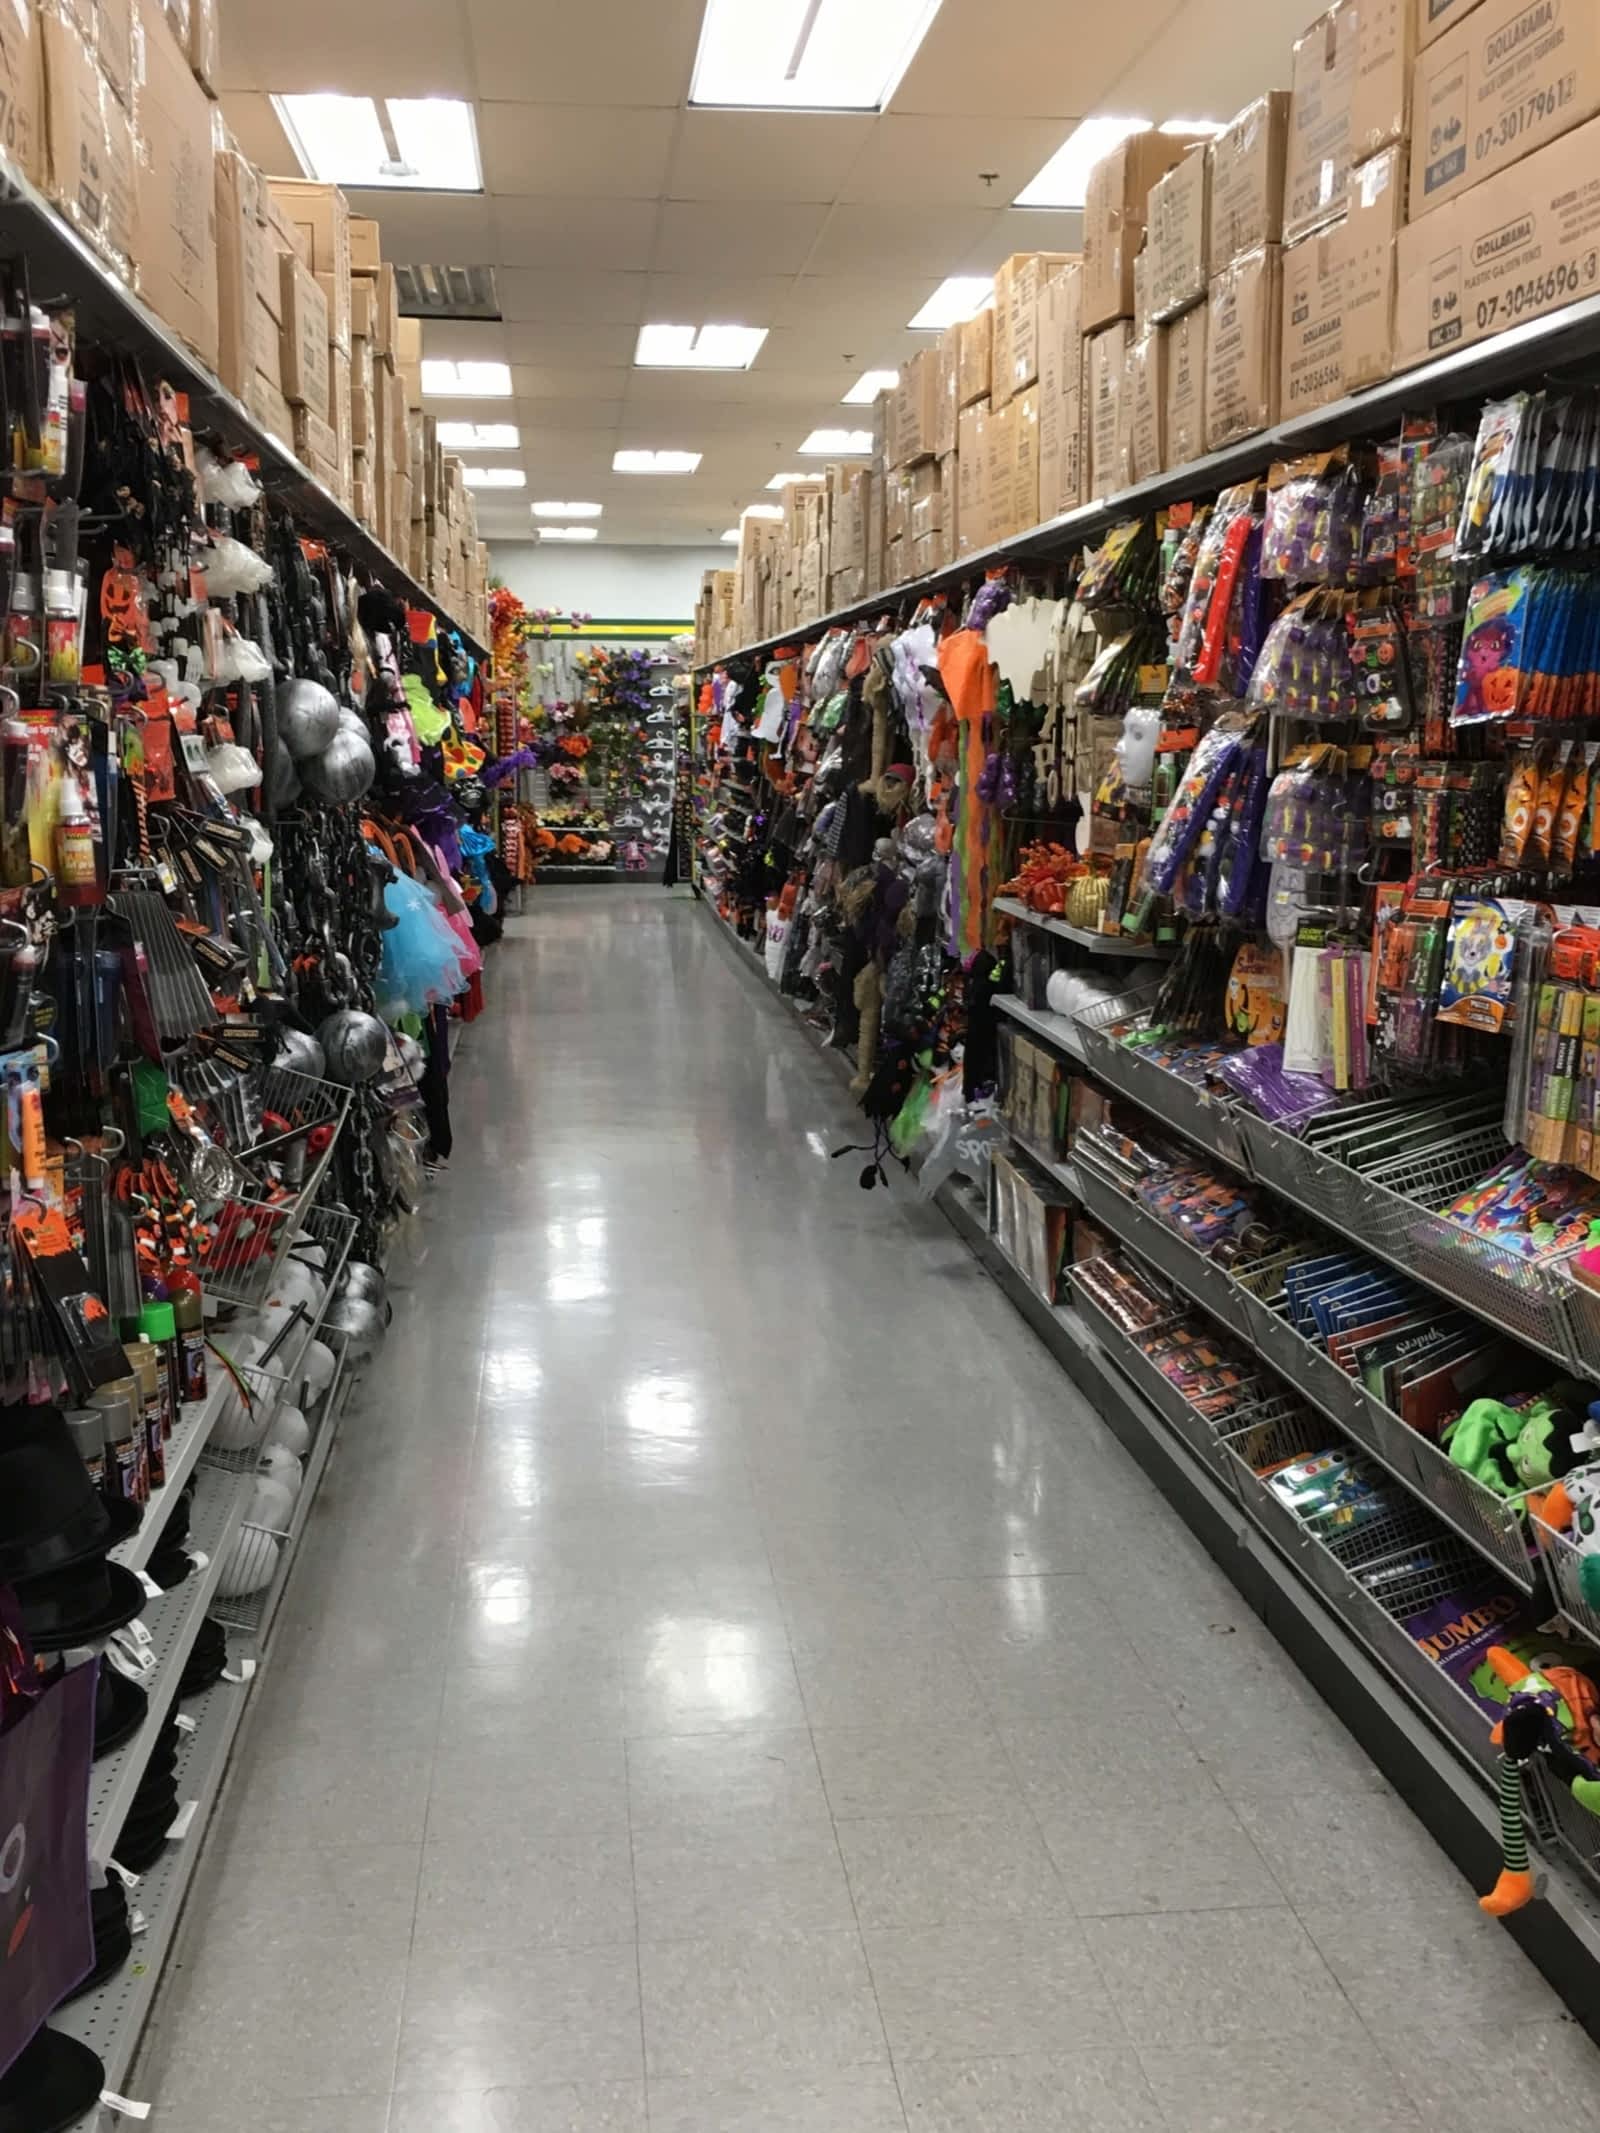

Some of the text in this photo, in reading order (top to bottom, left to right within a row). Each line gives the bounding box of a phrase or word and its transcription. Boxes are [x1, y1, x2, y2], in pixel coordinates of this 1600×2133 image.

[1487, 2, 1553, 65] DOLLARAMA
[1477, 221, 1532, 259] DOLLARAMA
[955, 1139, 991, 1166] spo
[1418, 1596, 1515, 1662] JUMBO
